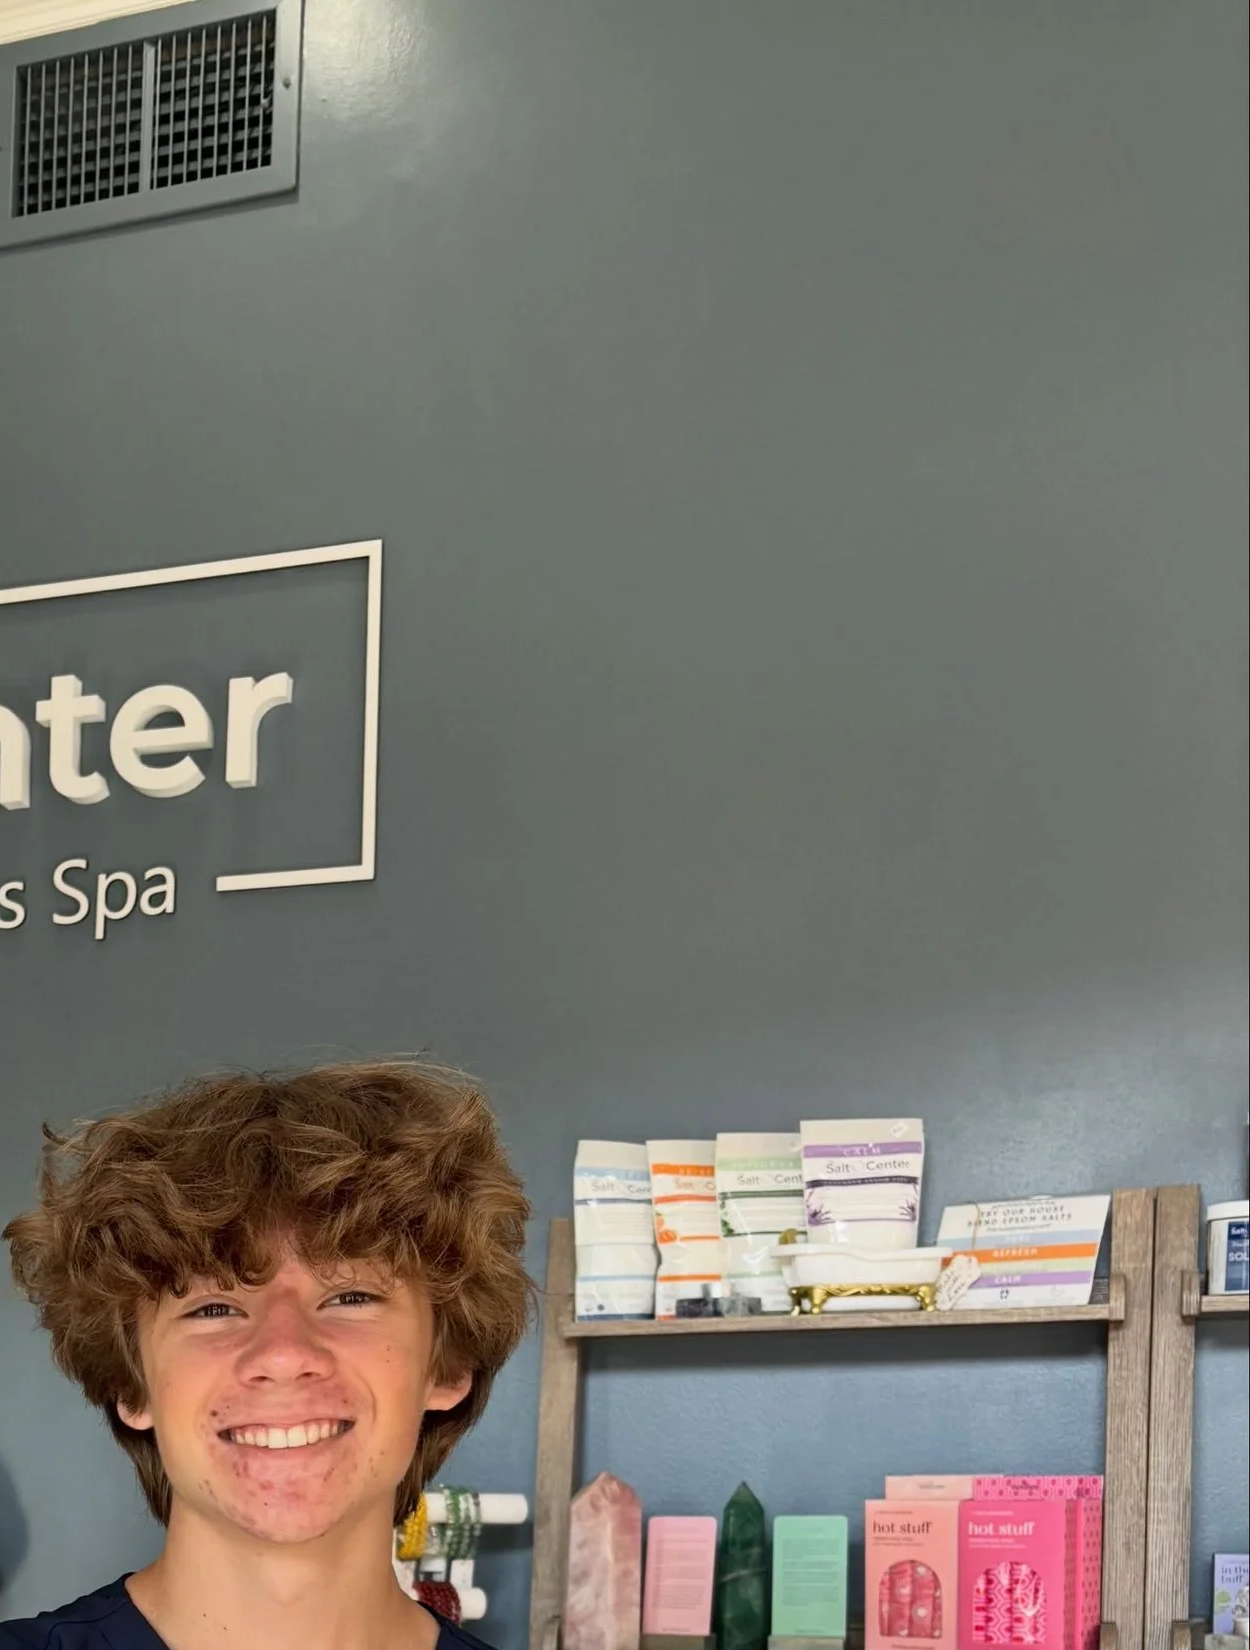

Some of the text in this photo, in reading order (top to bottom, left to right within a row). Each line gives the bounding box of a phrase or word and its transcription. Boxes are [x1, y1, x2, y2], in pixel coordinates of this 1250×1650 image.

[51, 857, 177, 941] Spa
[826, 1159, 910, 1174] Salt Center
[591, 1181, 615, 1192] Salt
[737, 1172, 803, 1187] Salt Cent
[1029, 1204, 1066, 1214] HOUSE
[994, 1274, 1023, 1285] CALM
[873, 1521, 932, 1534] hot stuff
[968, 1520, 1036, 1537] hot stuff
